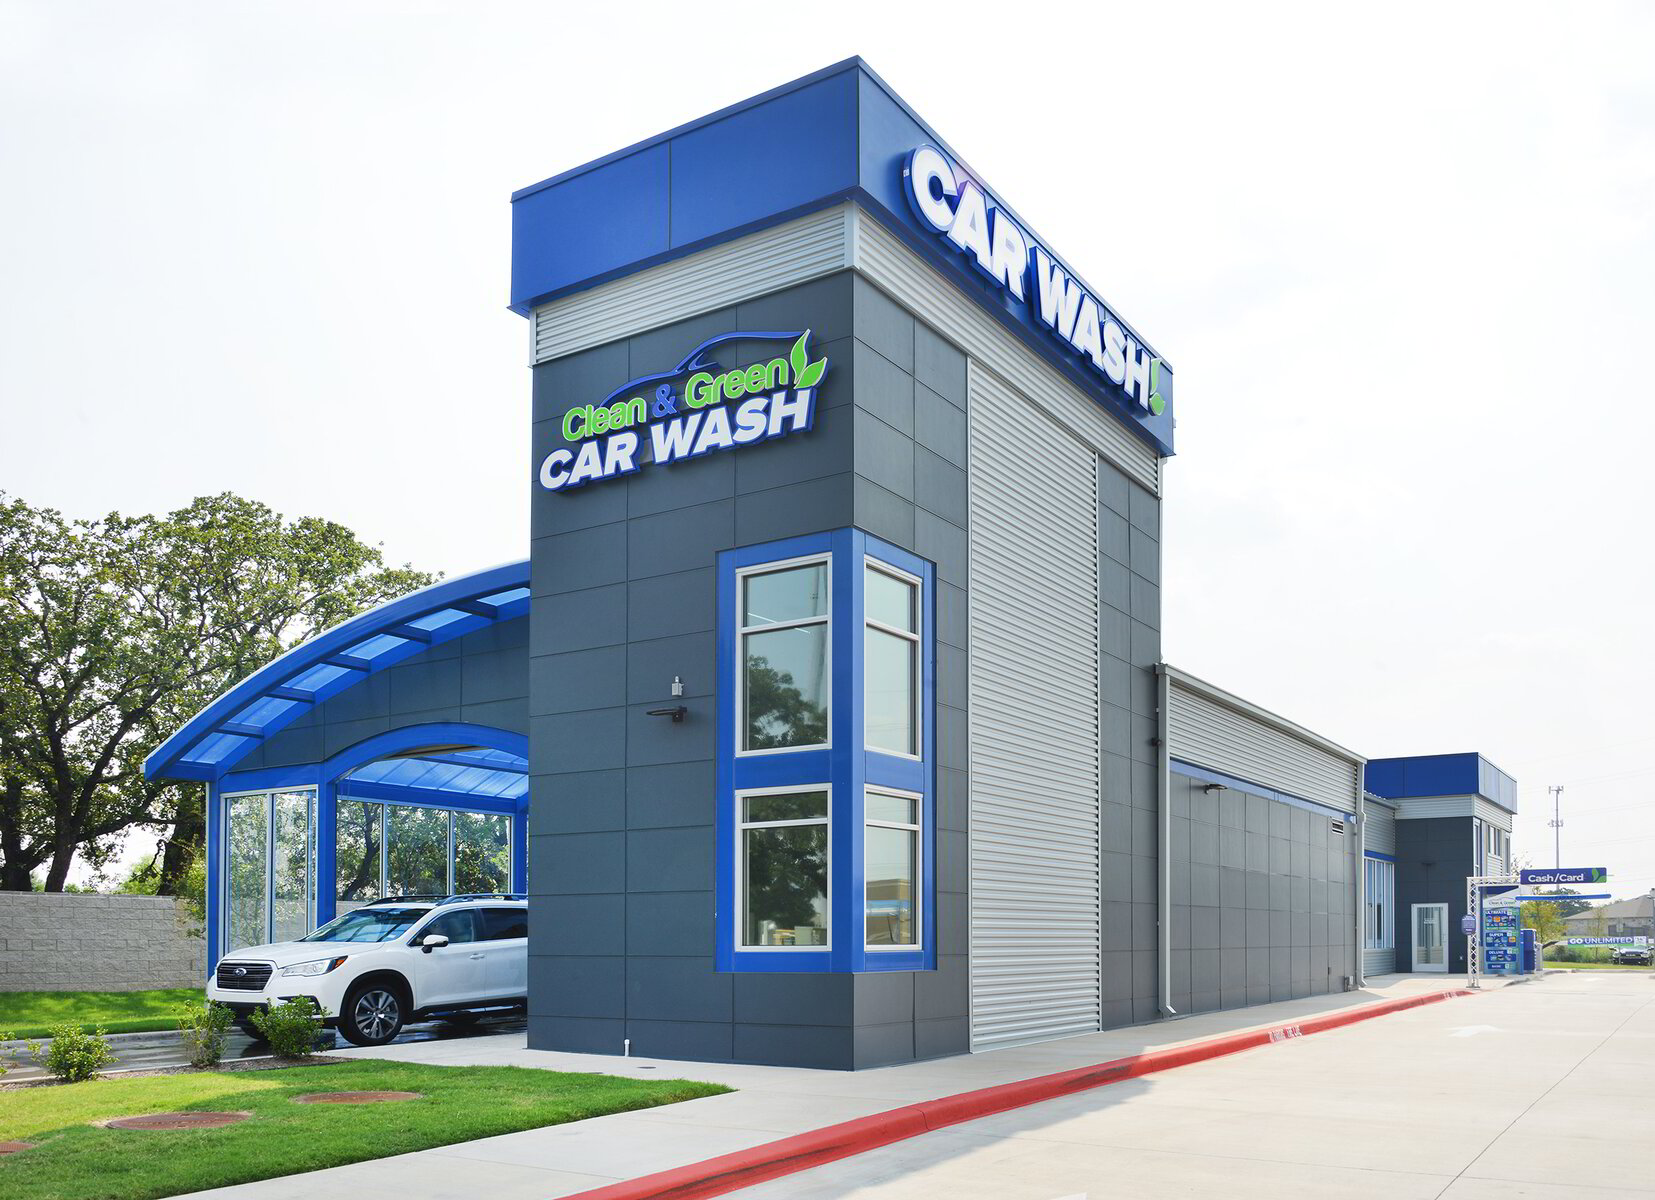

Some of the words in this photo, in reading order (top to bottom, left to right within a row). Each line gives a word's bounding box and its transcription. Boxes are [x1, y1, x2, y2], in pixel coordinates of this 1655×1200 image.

[902, 143, 1026, 304] CAR
[539, 430, 641, 490] CAR
[650, 387, 815, 466] WASH
[562, 397, 647, 442] Clean
[652, 383, 678, 418] &
[685, 356, 789, 410] Green
[1528, 872, 1584, 883] Cash/Card
